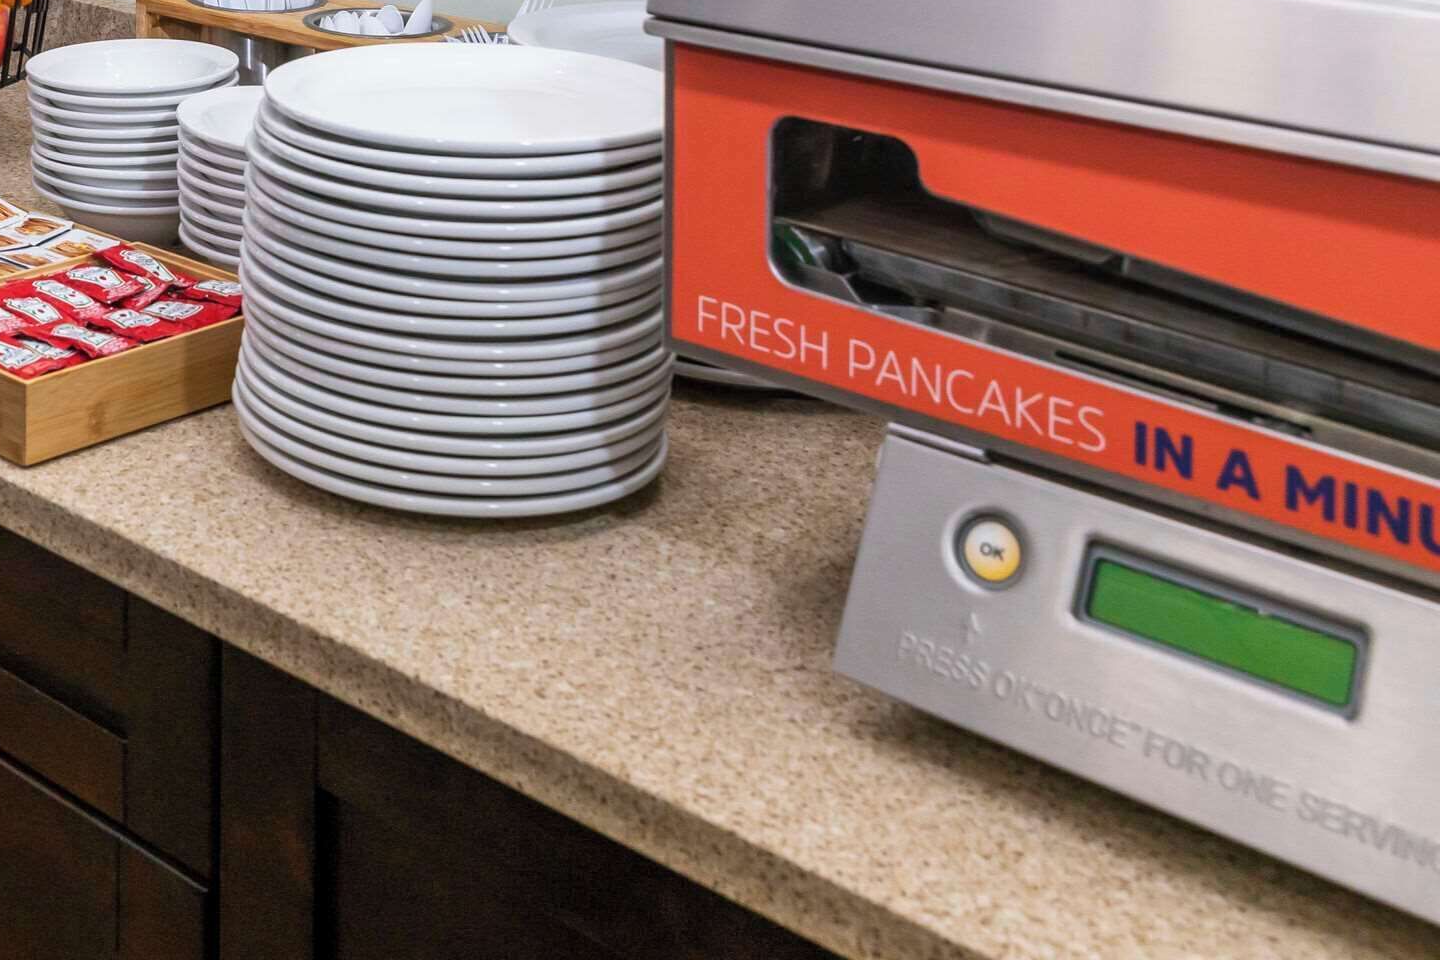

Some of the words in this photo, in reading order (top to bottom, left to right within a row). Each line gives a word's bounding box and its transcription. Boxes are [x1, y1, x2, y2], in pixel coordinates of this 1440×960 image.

[697, 295, 828, 369] FRESH
[848, 339, 1107, 453] PANCAKES
[1135, 422, 1193, 480] IN
[1216, 449, 1260, 500] A
[980, 542, 1005, 562] OK
[897, 631, 990, 687] PRESS
[1143, 730, 1209, 781] FOR
[1216, 760, 1292, 813] ONE
